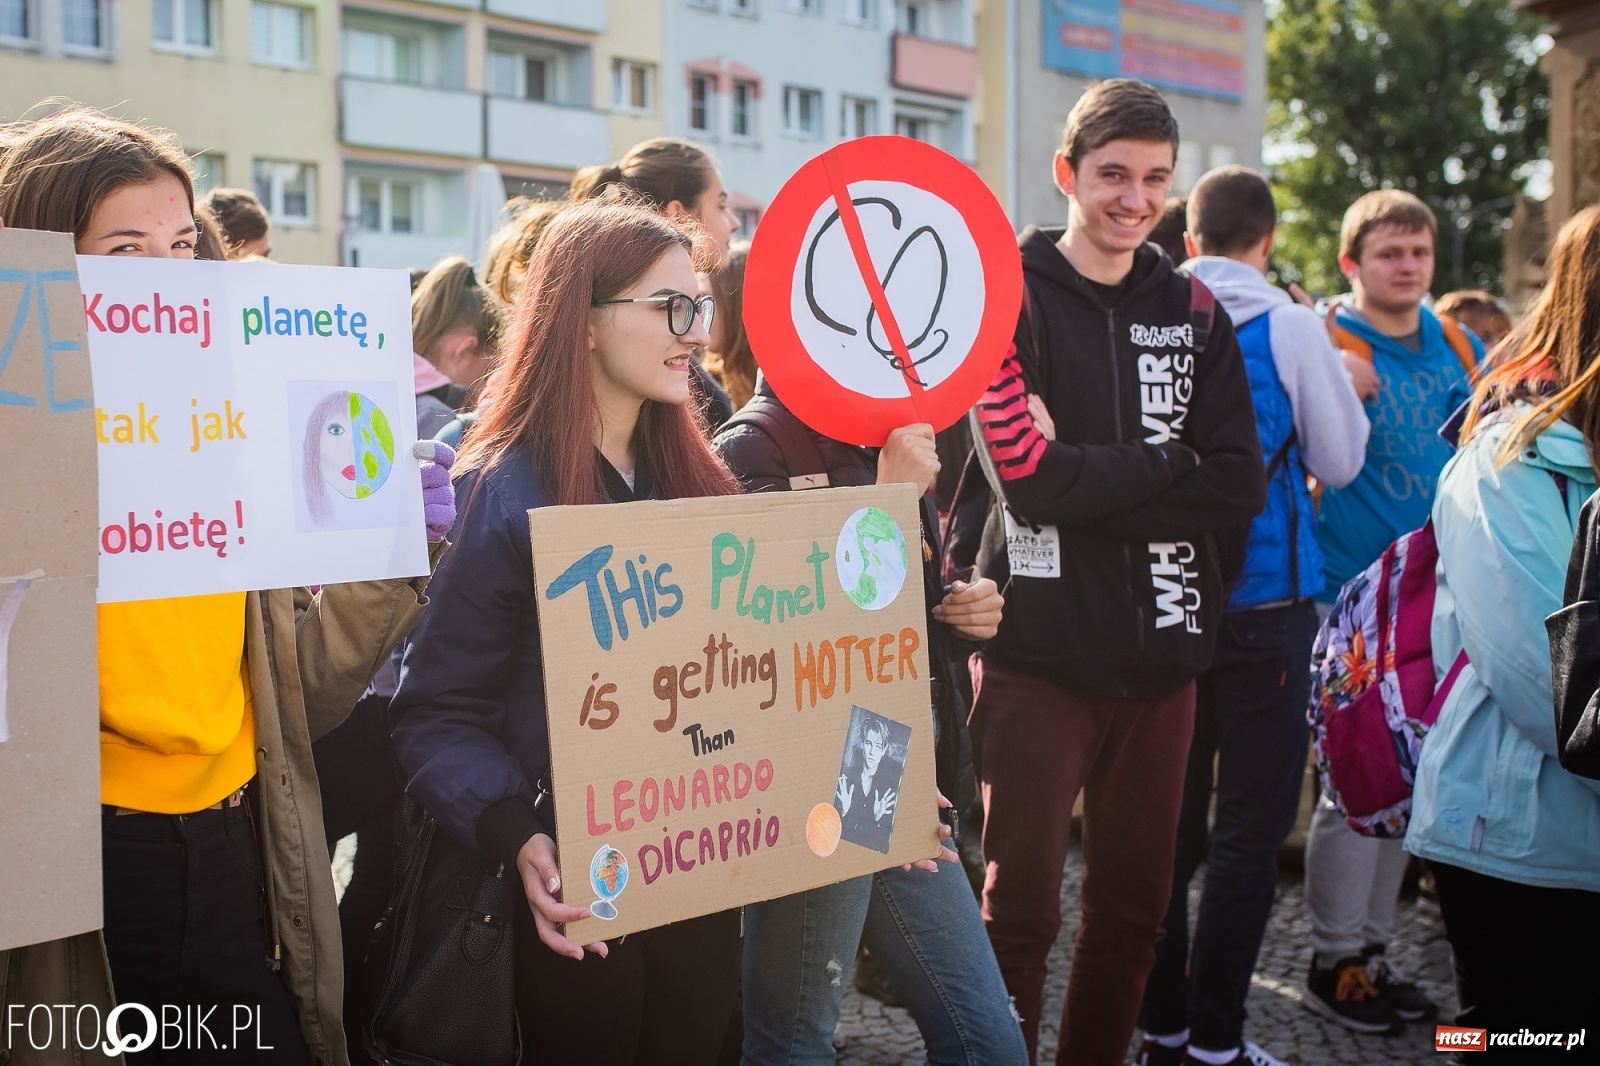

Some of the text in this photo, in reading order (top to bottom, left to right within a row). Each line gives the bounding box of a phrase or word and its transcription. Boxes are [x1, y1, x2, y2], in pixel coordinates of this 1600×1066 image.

[82, 292, 211, 348] Kochaj
[95, 398, 248, 452] tak jak
[98, 500, 246, 558] obietę!
[710, 531, 829, 625] Planet
[579, 627, 920, 733] is getting HOTTER
[682, 723, 735, 758] Than
[586, 758, 774, 837] LEONARDO
